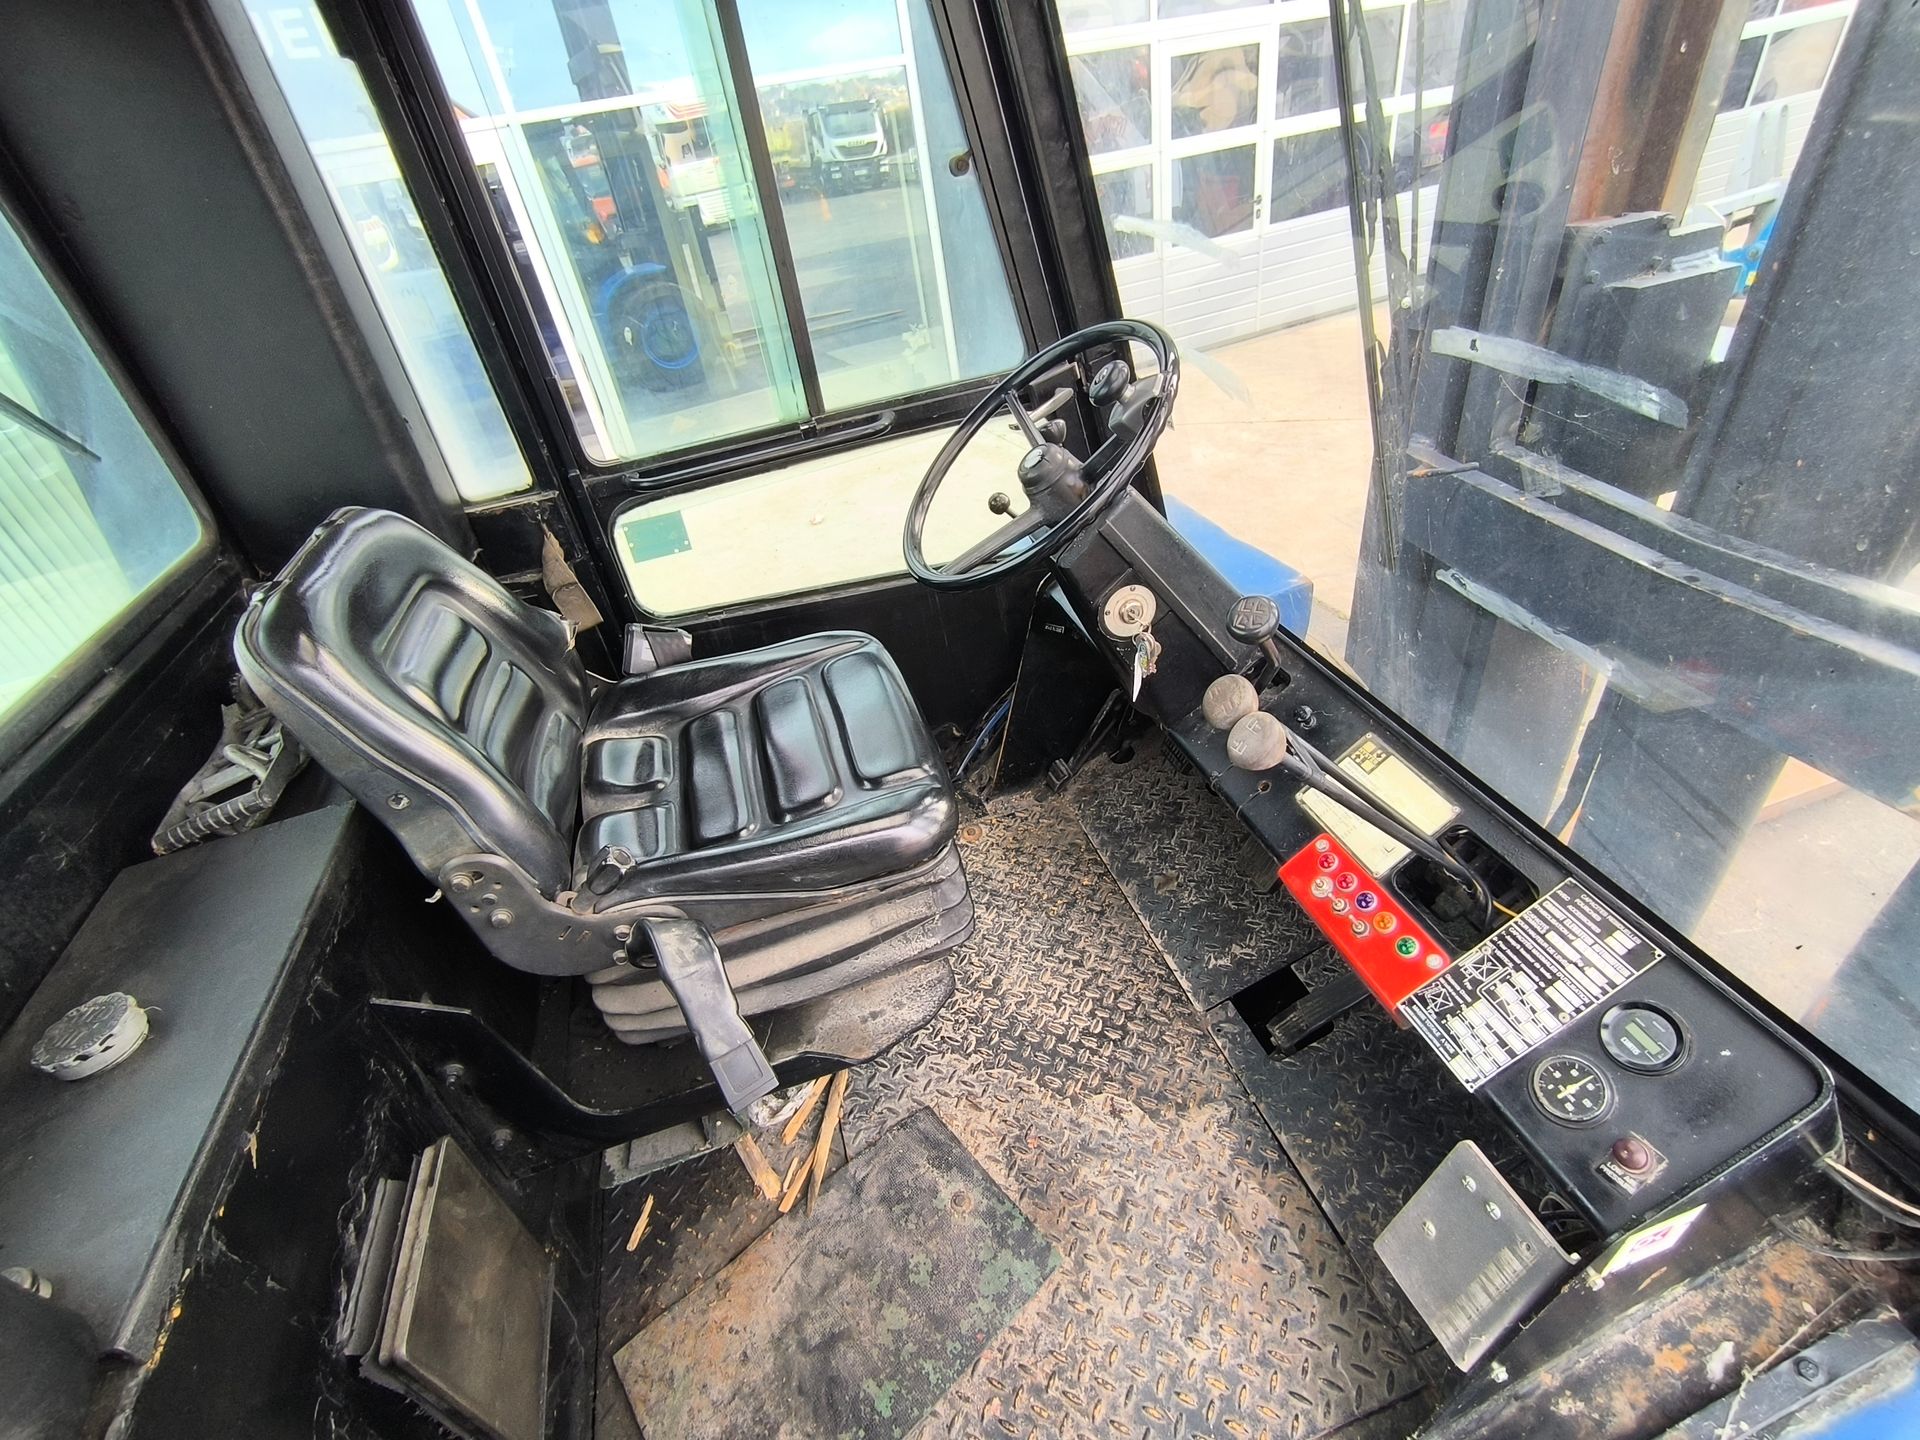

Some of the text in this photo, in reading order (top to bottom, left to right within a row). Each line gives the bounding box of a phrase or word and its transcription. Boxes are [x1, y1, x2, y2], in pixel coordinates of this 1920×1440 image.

[1620, 1037, 1640, 1054] CURTIS
[1599, 1165, 1634, 1192] PRESSURE
[1607, 1161, 1638, 1187] LOW AIR
